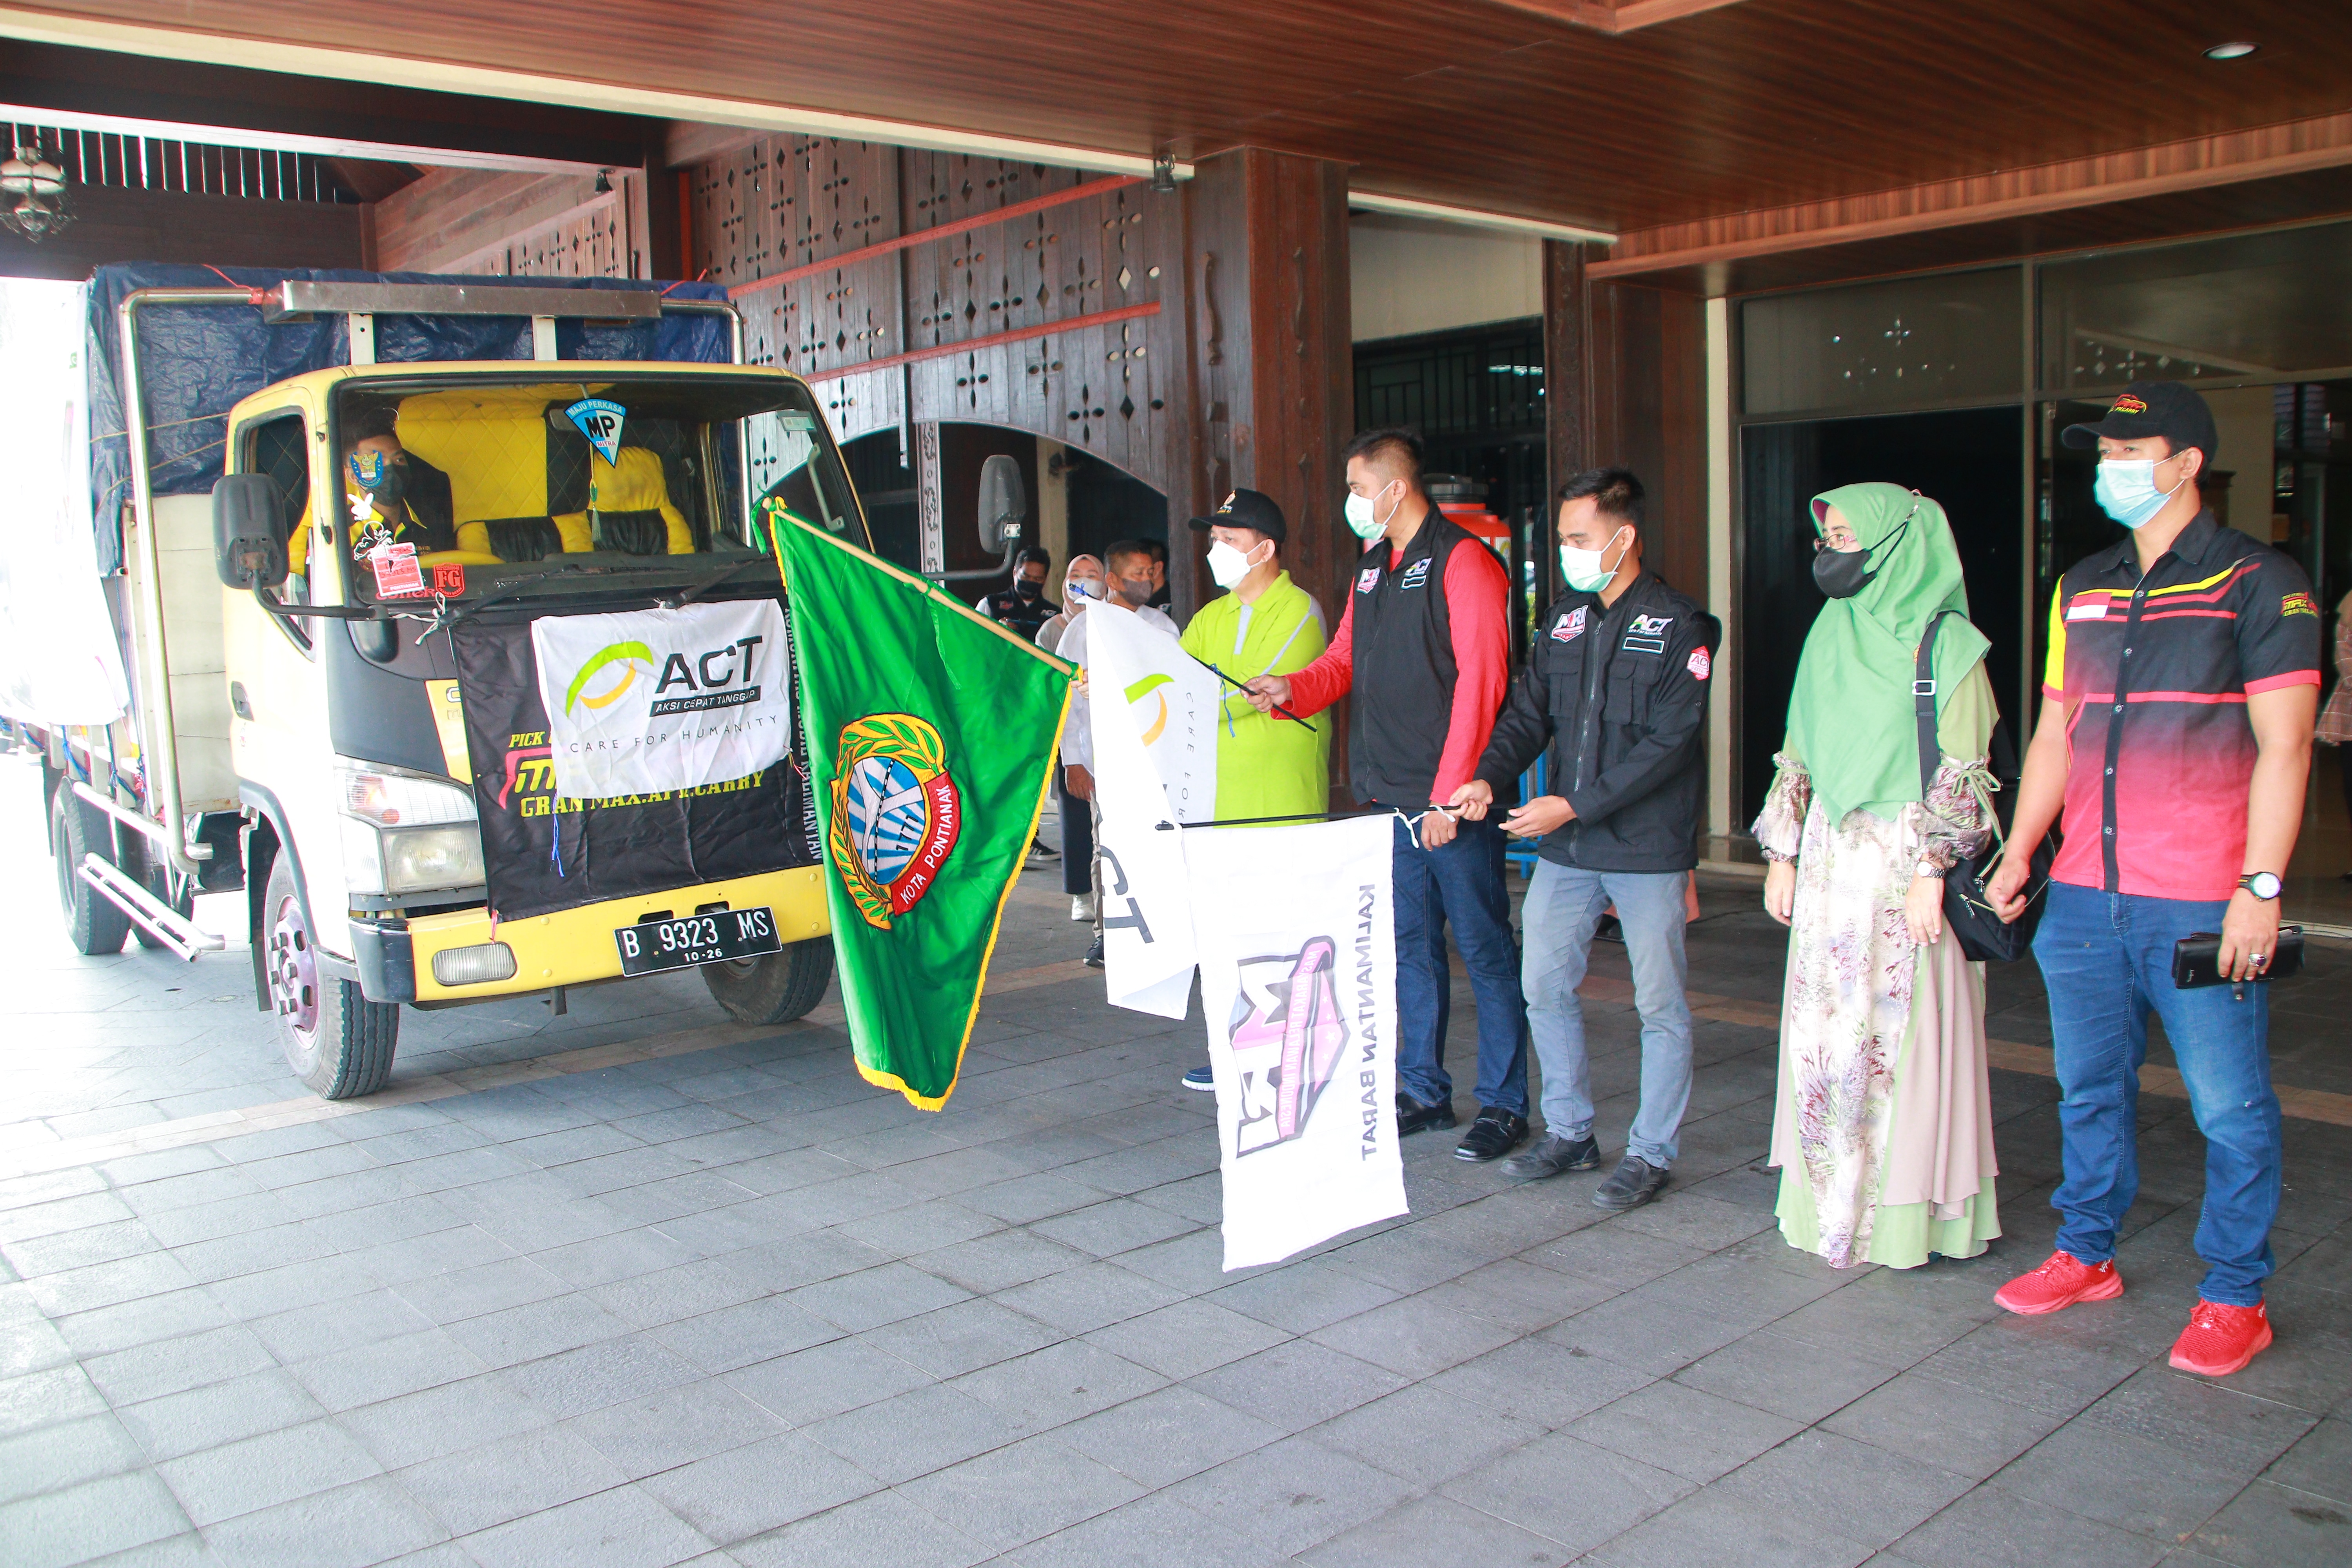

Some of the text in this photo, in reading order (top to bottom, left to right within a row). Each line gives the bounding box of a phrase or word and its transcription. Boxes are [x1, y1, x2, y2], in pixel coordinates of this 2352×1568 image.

[568, 401, 622, 416] MAJU PERKASA
[584, 415, 615, 438] MP
[390, 582, 419, 591] PONTIANAK
[436, 570, 461, 588] FG
[1628, 613, 1673, 633] ACT
[655, 635, 763, 694] ACT
[655, 701, 680, 713] AKSI
[683, 697, 715, 710] CEPAT
[508, 731, 545, 748] PICK
[570, 715, 777, 753] CARE FOR HUMANITY
[520, 795, 584, 818] GRAN
[895, 814, 918, 851] 1771
[900, 784, 953, 905] KOTA PONTIANAK
[622, 910, 770, 958] B 9323 MS
